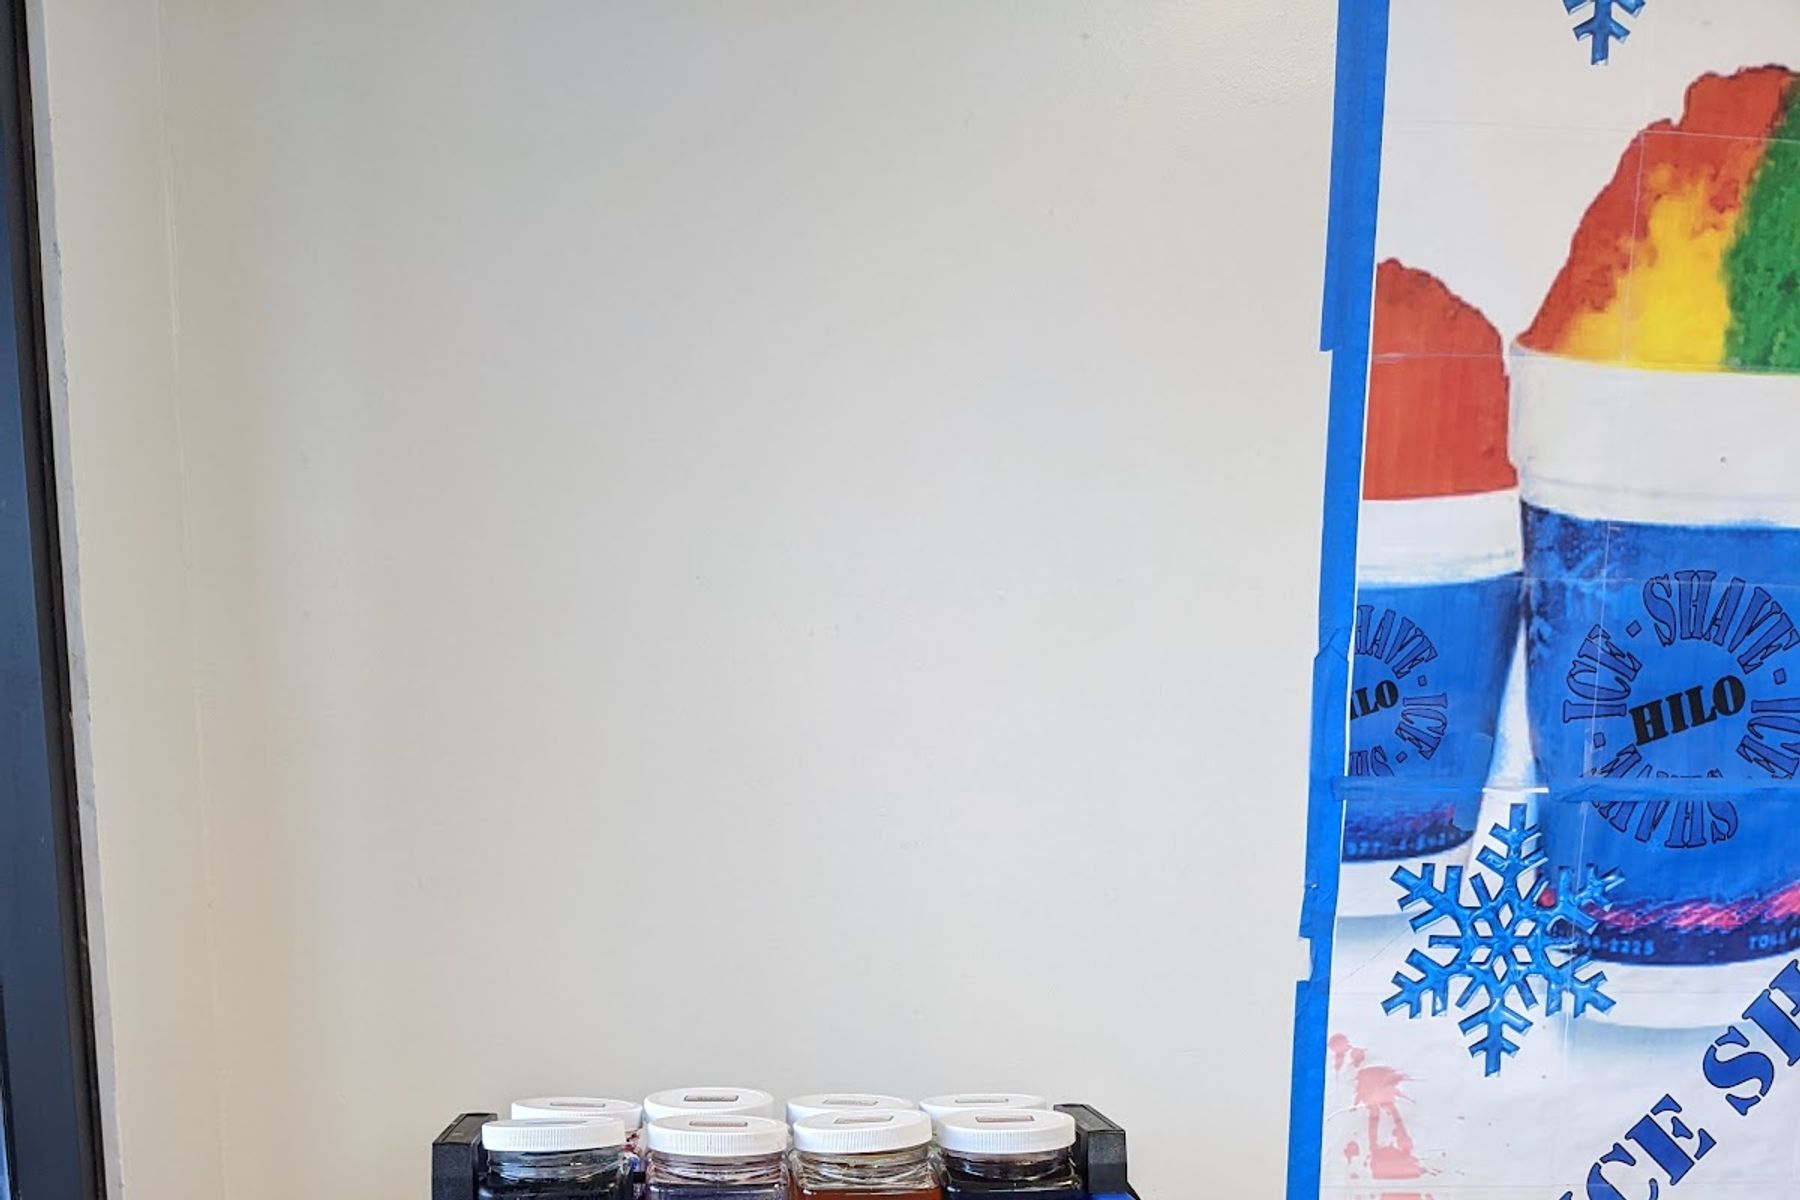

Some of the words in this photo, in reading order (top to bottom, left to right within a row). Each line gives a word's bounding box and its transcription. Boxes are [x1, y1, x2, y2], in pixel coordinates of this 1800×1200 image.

[1643, 570, 1800, 675] SHAVE
[1563, 624, 1643, 723] ICE
[1628, 675, 1746, 746] HILO
[1395, 693, 1449, 760] ICE
